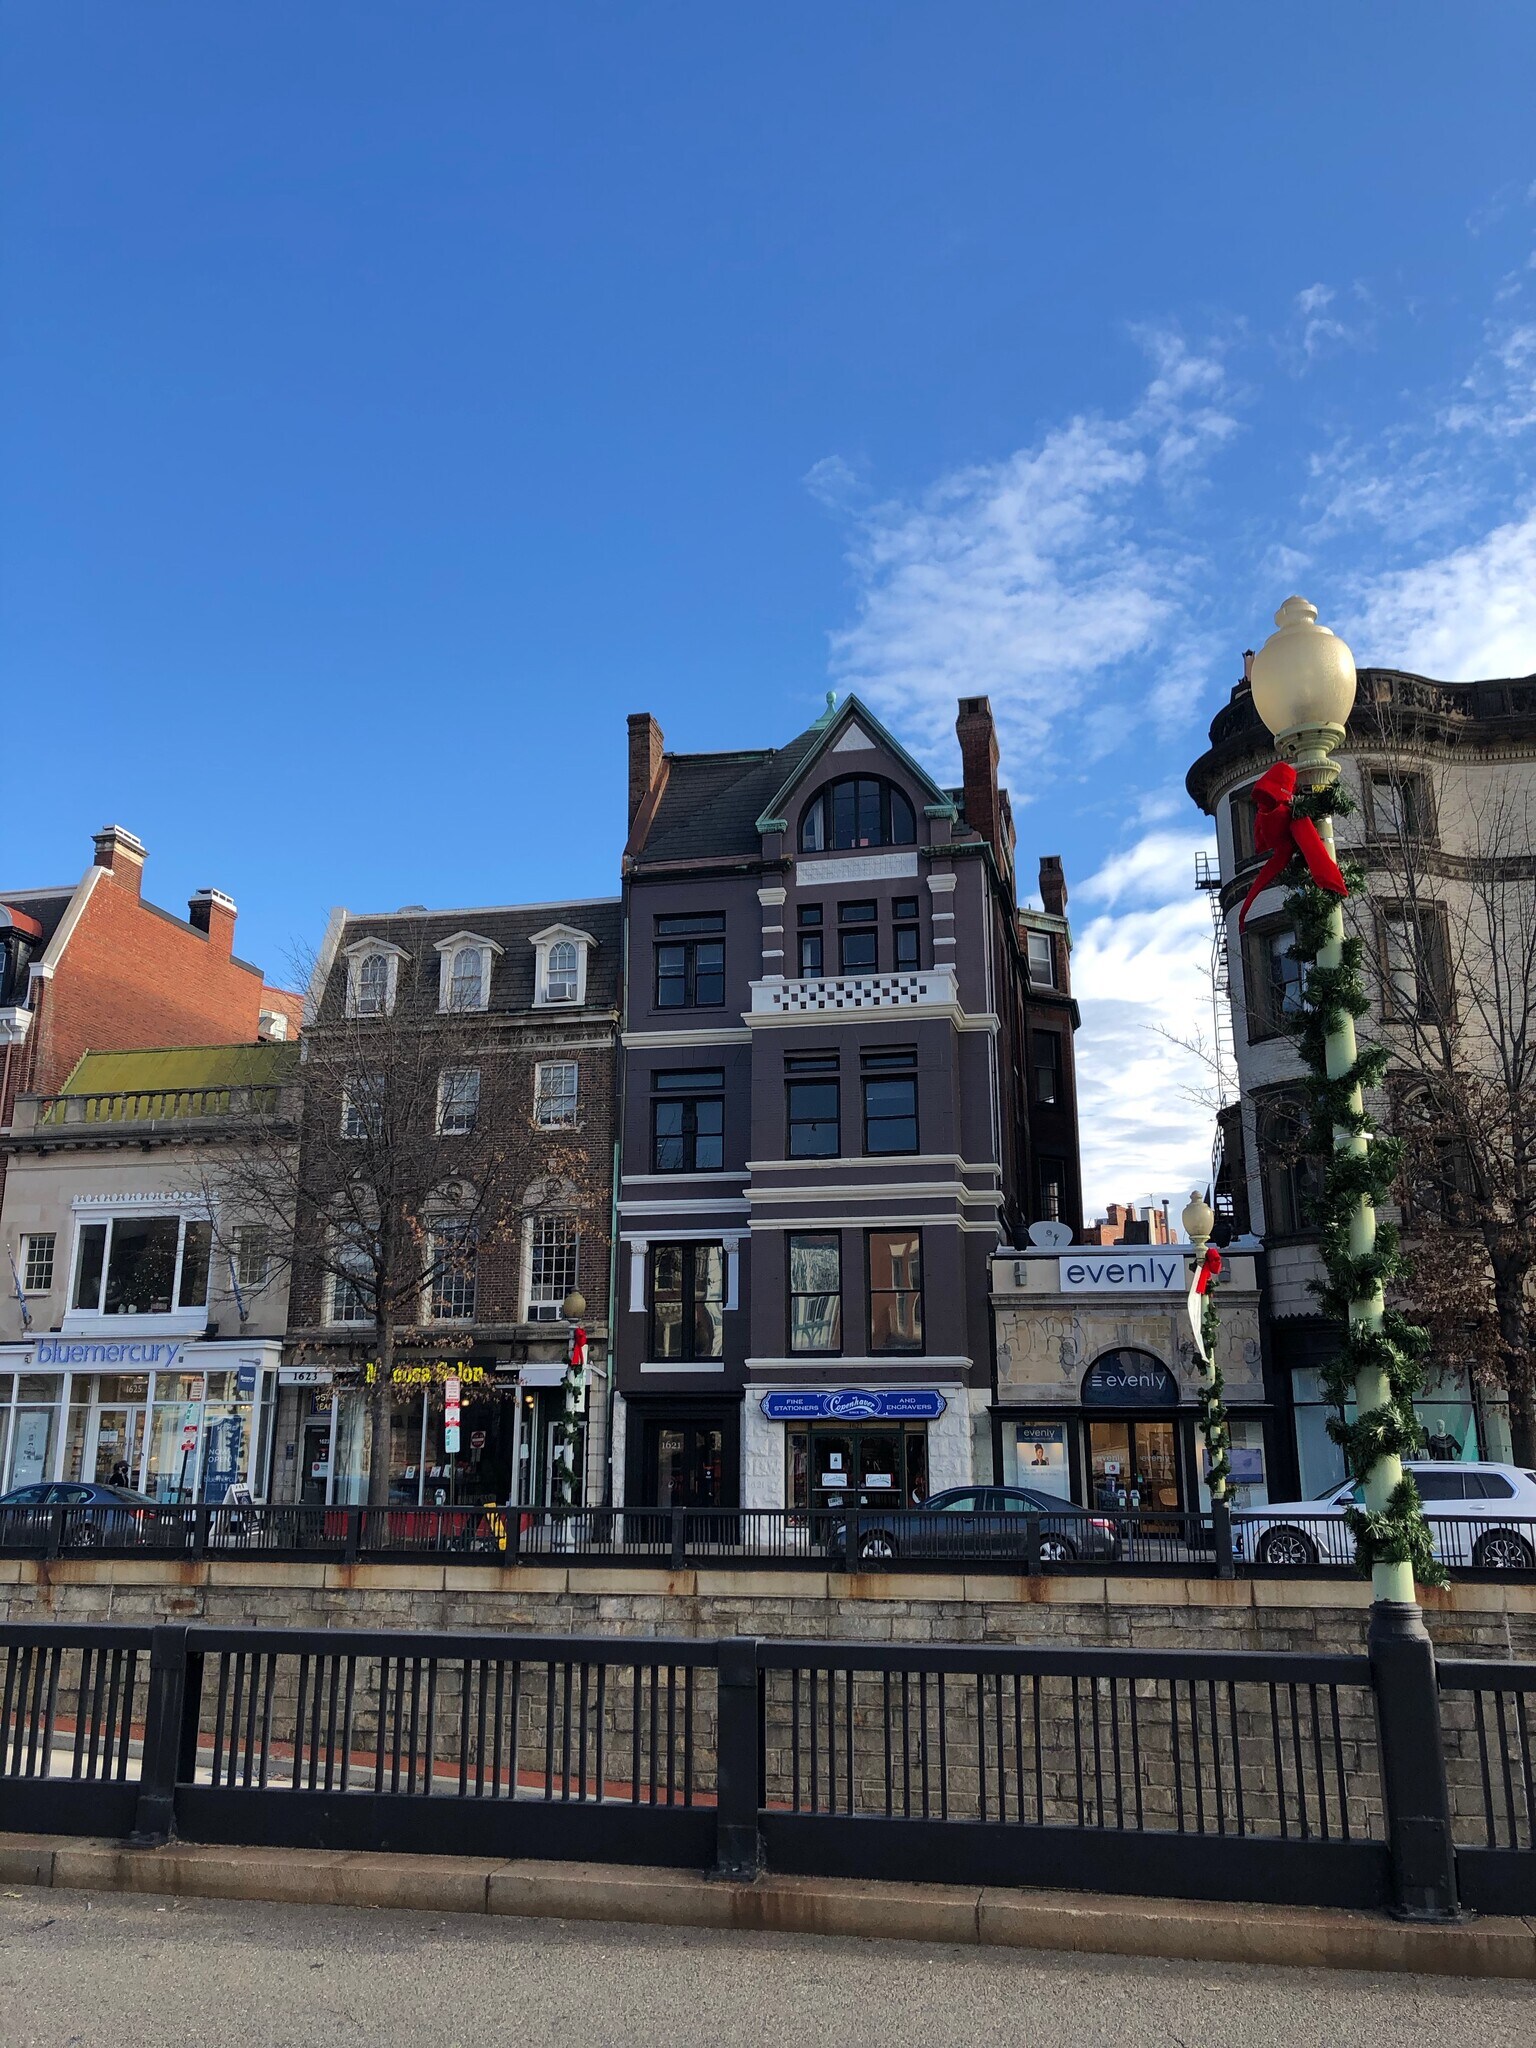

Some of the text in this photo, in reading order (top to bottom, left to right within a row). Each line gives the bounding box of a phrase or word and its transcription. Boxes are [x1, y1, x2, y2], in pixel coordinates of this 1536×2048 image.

[1067, 1258, 1176, 1288] evenly
[38, 1338, 180, 1368] bluemercury
[293, 1372, 317, 1381] 1623
[1106, 1372, 1166, 1390] evenly
[125, 1385, 142, 1393] 1625
[828, 1395, 877, 1415] Copenhaver
[1023, 1428, 1056, 1439] evenly
[661, 1441, 681, 1450] 1621
